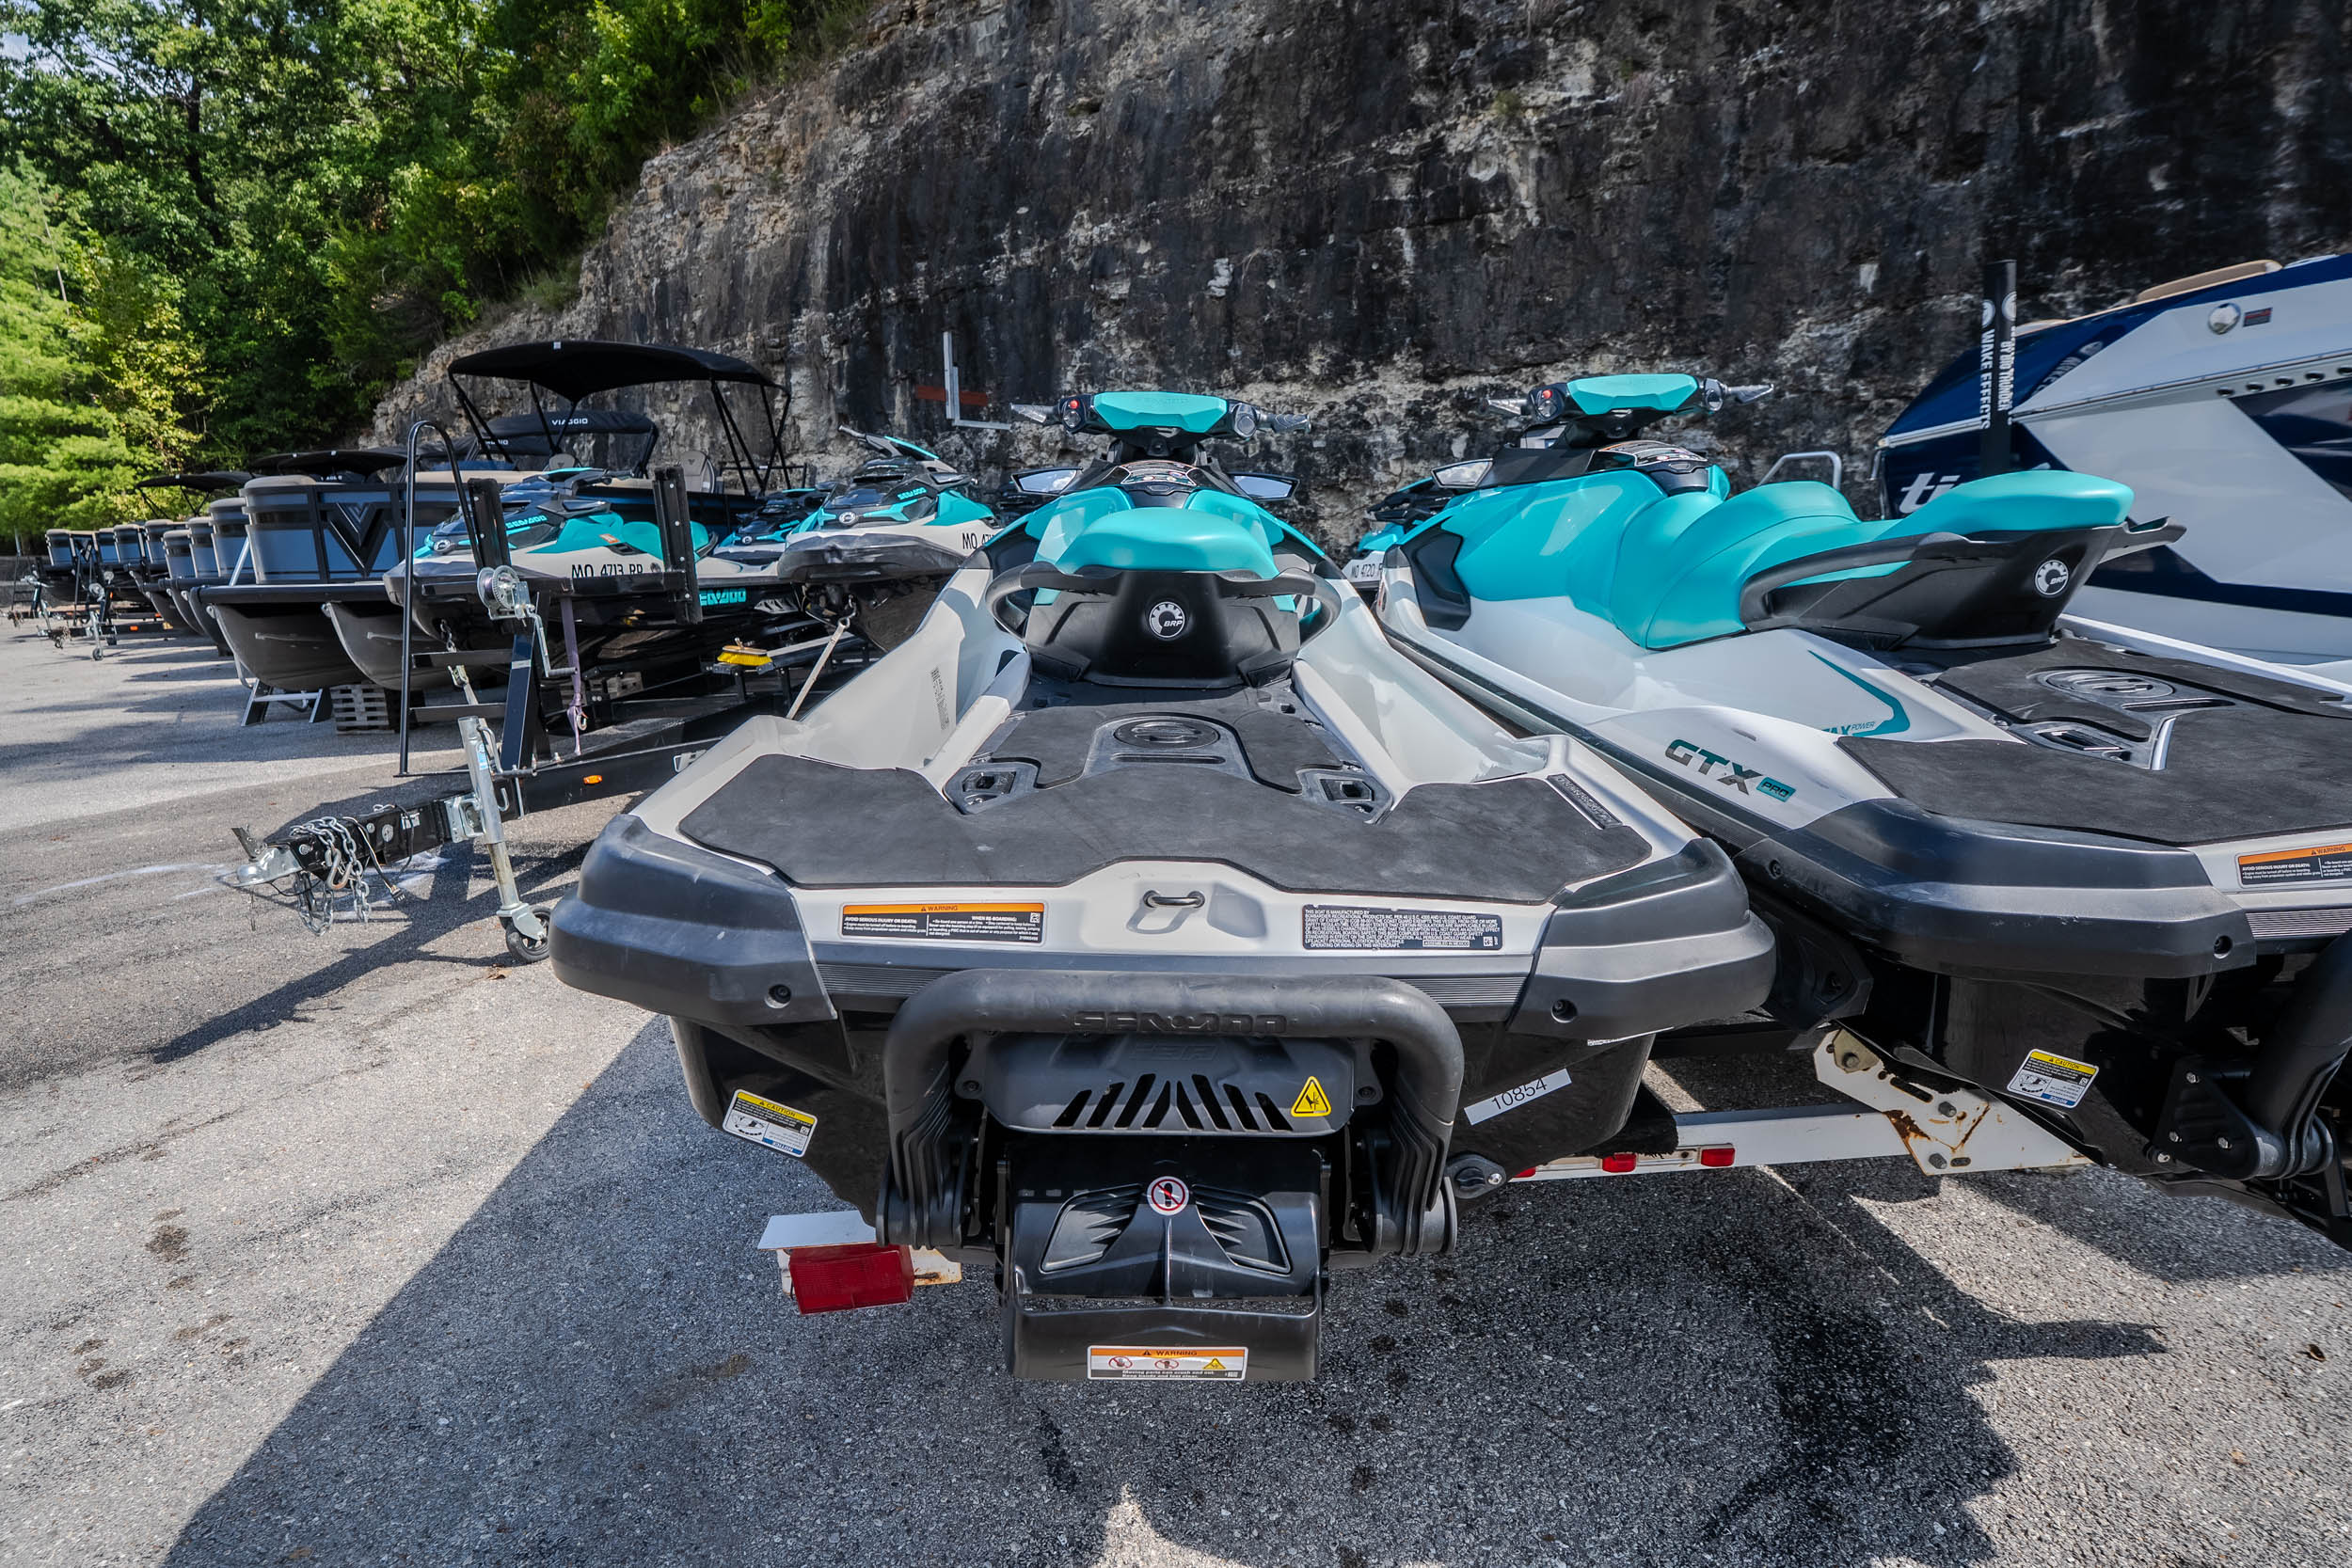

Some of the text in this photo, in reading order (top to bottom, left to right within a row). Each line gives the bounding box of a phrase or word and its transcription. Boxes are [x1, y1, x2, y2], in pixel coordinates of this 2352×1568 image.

[1979, 329, 1994, 429] WAKE EFFECTS
[962, 533, 977, 549] MO
[572, 564, 594, 578] MO
[601, 564, 624, 576] 4713
[1851, 721, 1875, 730] POWER
[1665, 739, 1789, 798] GTX PRO
[2055, 1060, 2080, 1069] CAUTION
[1492, 1078, 1547, 1110] 10854
[766, 1103, 796, 1117] CAUTION
